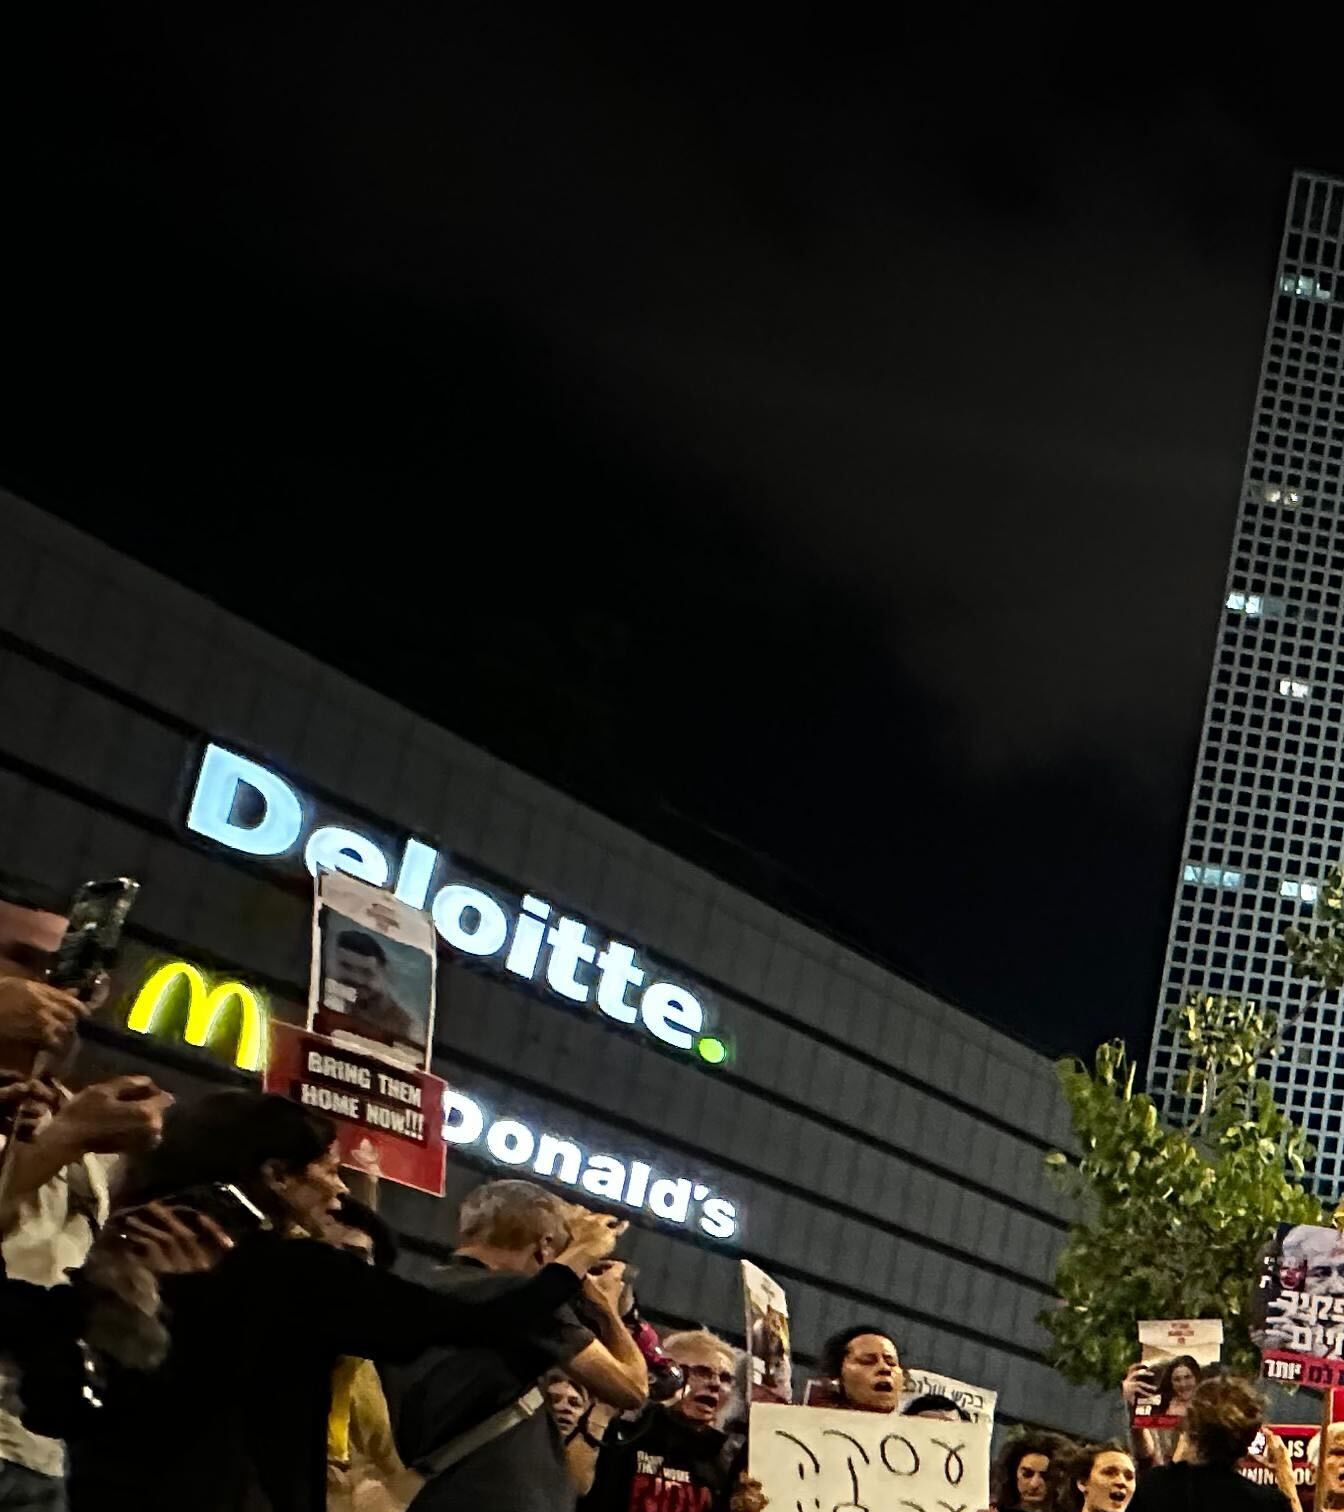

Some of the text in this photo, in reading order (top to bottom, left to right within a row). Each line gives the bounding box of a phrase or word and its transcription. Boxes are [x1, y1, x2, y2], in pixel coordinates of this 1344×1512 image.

[301, 1082, 360, 1119] HOME
[308, 1051, 422, 1108] BRING THEM
[441, 1090, 740, 1241] Donald's
